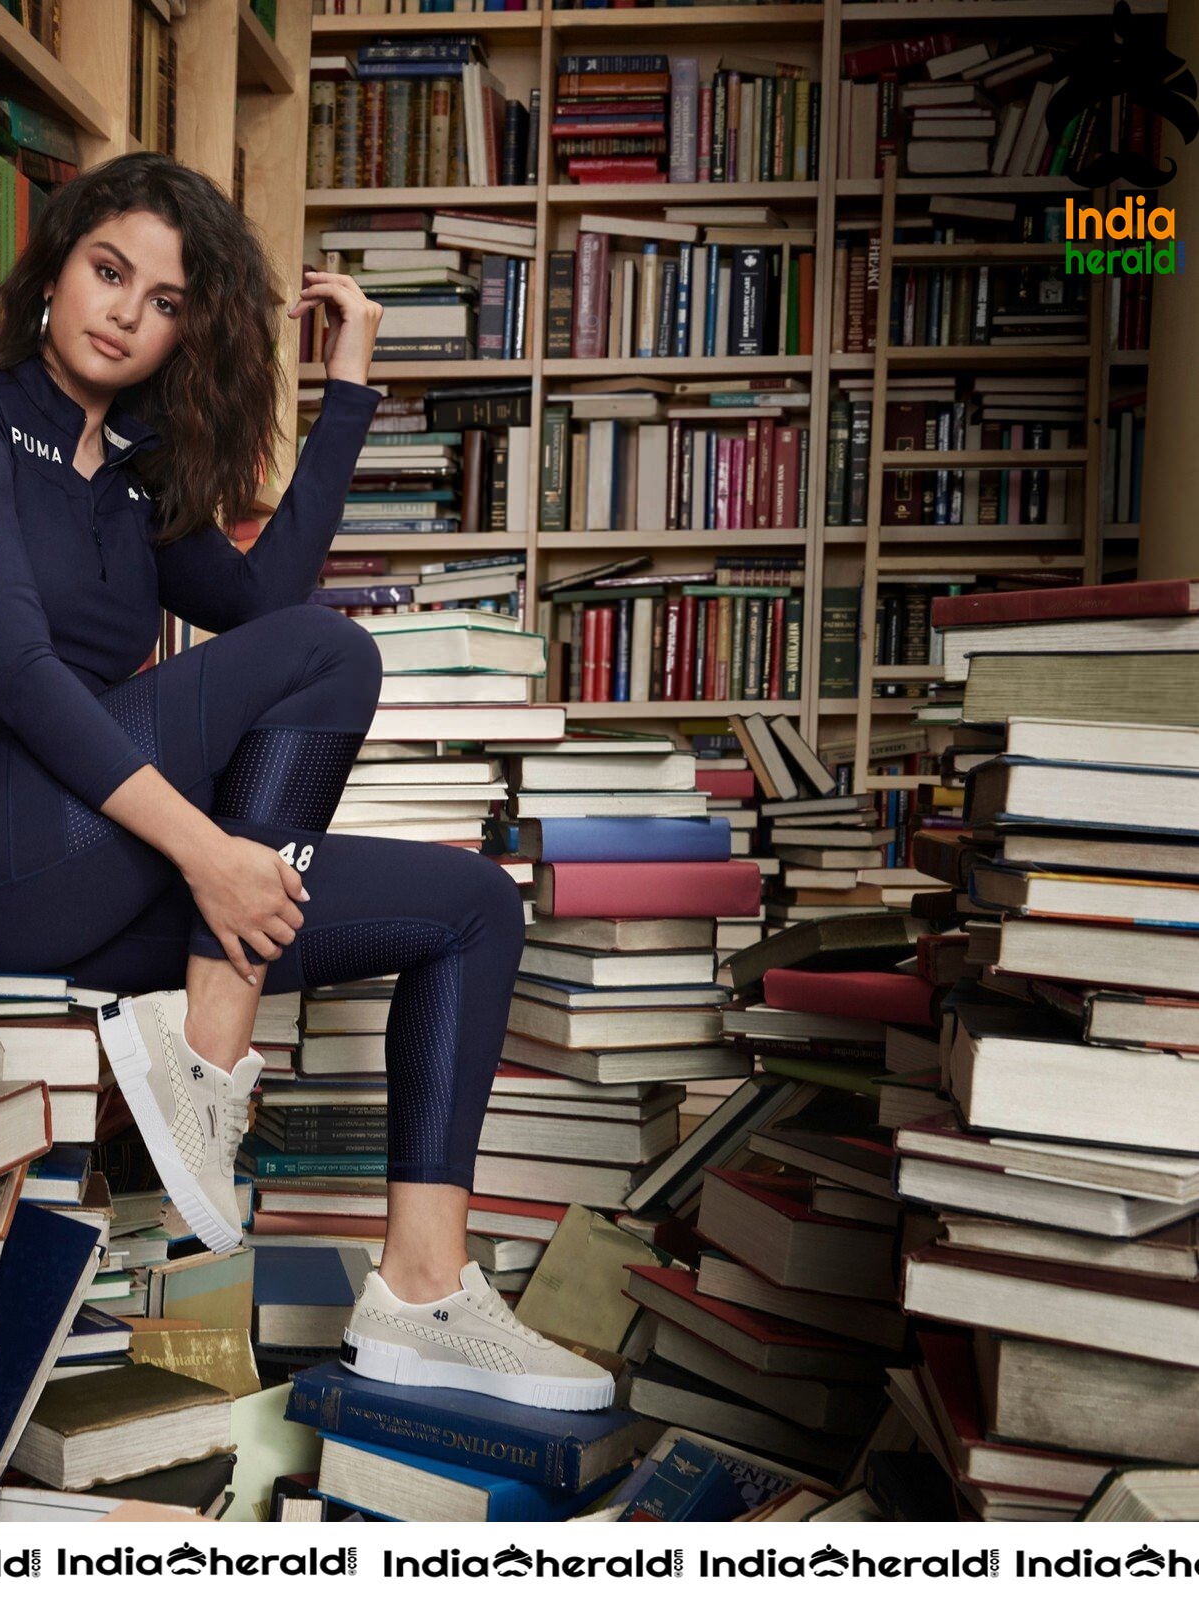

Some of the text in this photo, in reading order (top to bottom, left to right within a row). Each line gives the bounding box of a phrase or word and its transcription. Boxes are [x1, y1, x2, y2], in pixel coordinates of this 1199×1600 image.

[742, 276, 752, 338] RESPIRATORY CARE
[11, 426, 63, 464] PUMA
[551, 424, 561, 490] ENDOCRINOLOGY
[277, 841, 315, 873] 48
[191, 1065, 204, 1081] 92
[432, 1309, 449, 1322] 48
[140, 1350, 214, 1370] Psychiatric
[440, 1429, 539, 1467] PILOTING
